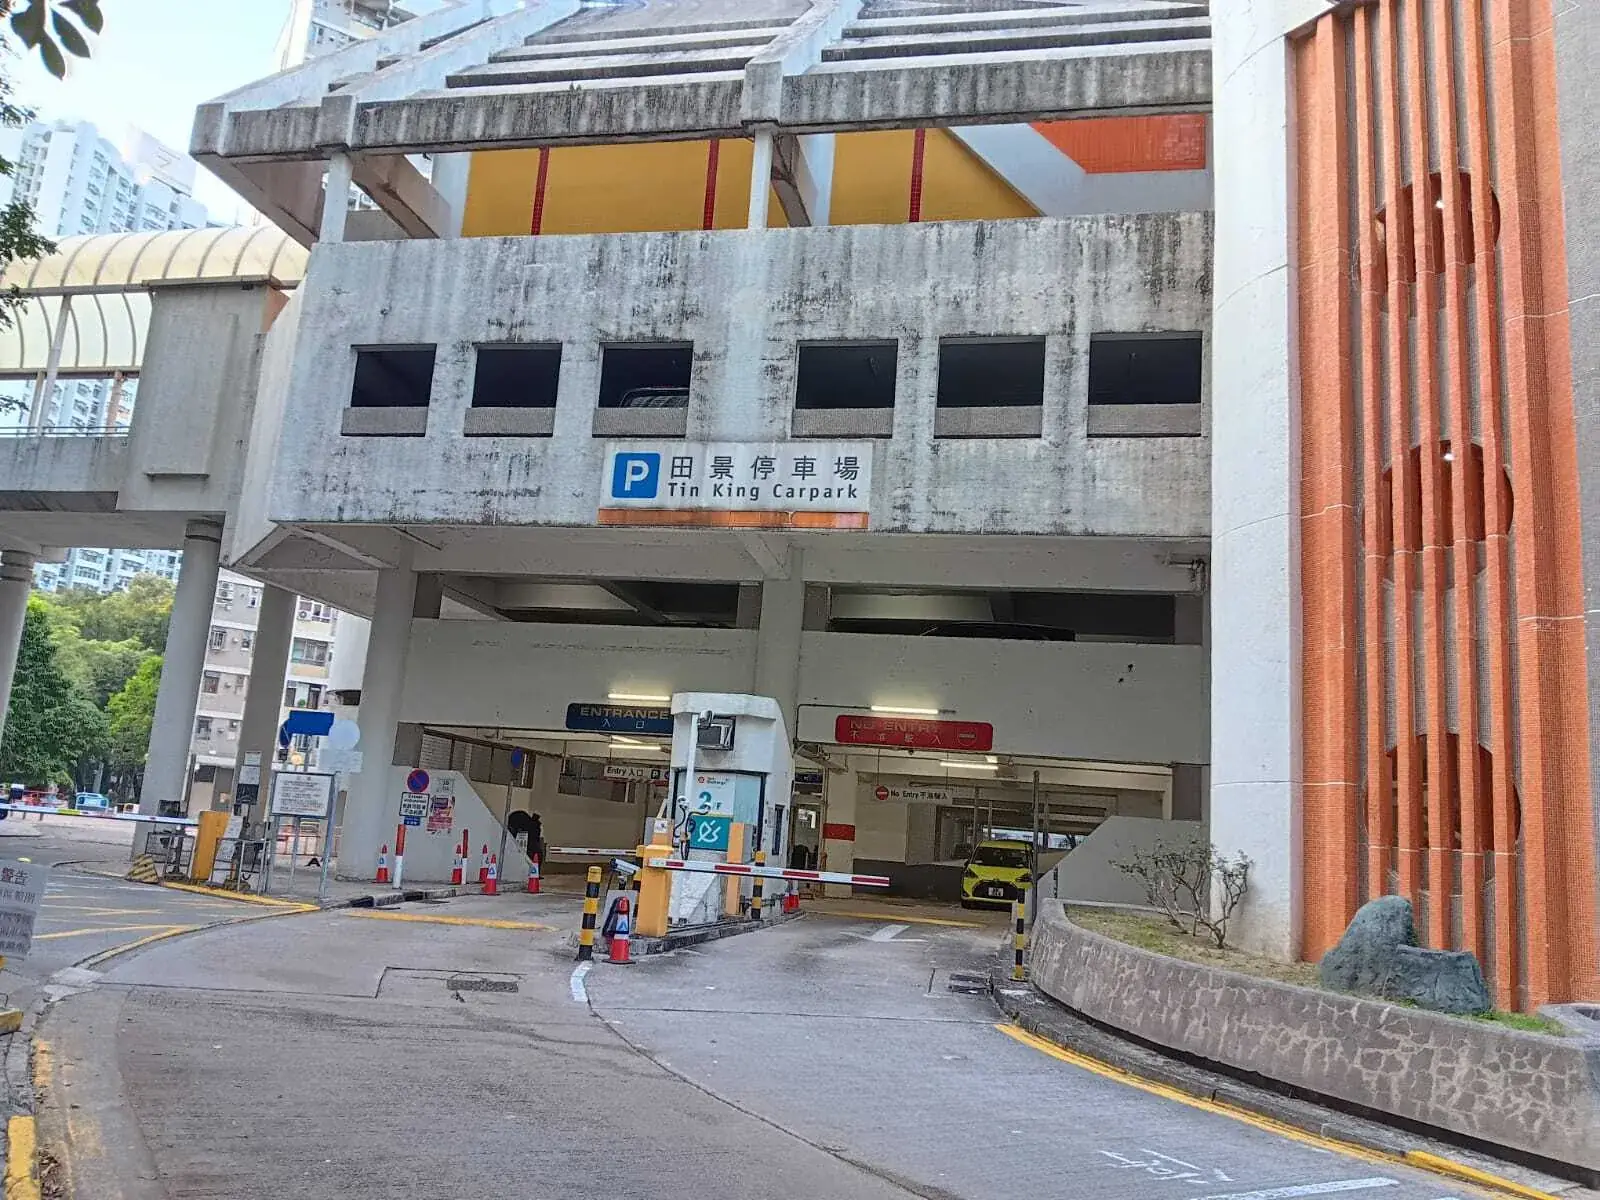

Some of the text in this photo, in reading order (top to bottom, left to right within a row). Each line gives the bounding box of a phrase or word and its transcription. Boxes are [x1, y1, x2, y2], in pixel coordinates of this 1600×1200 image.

[670, 455, 860, 481] 田景停車場
[668, 482, 858, 502] Tin King Carpark
[580, 707, 669, 720] ENTRANCE
[607, 766, 627, 776] Entry
[903, 790, 918, 799] Entry
